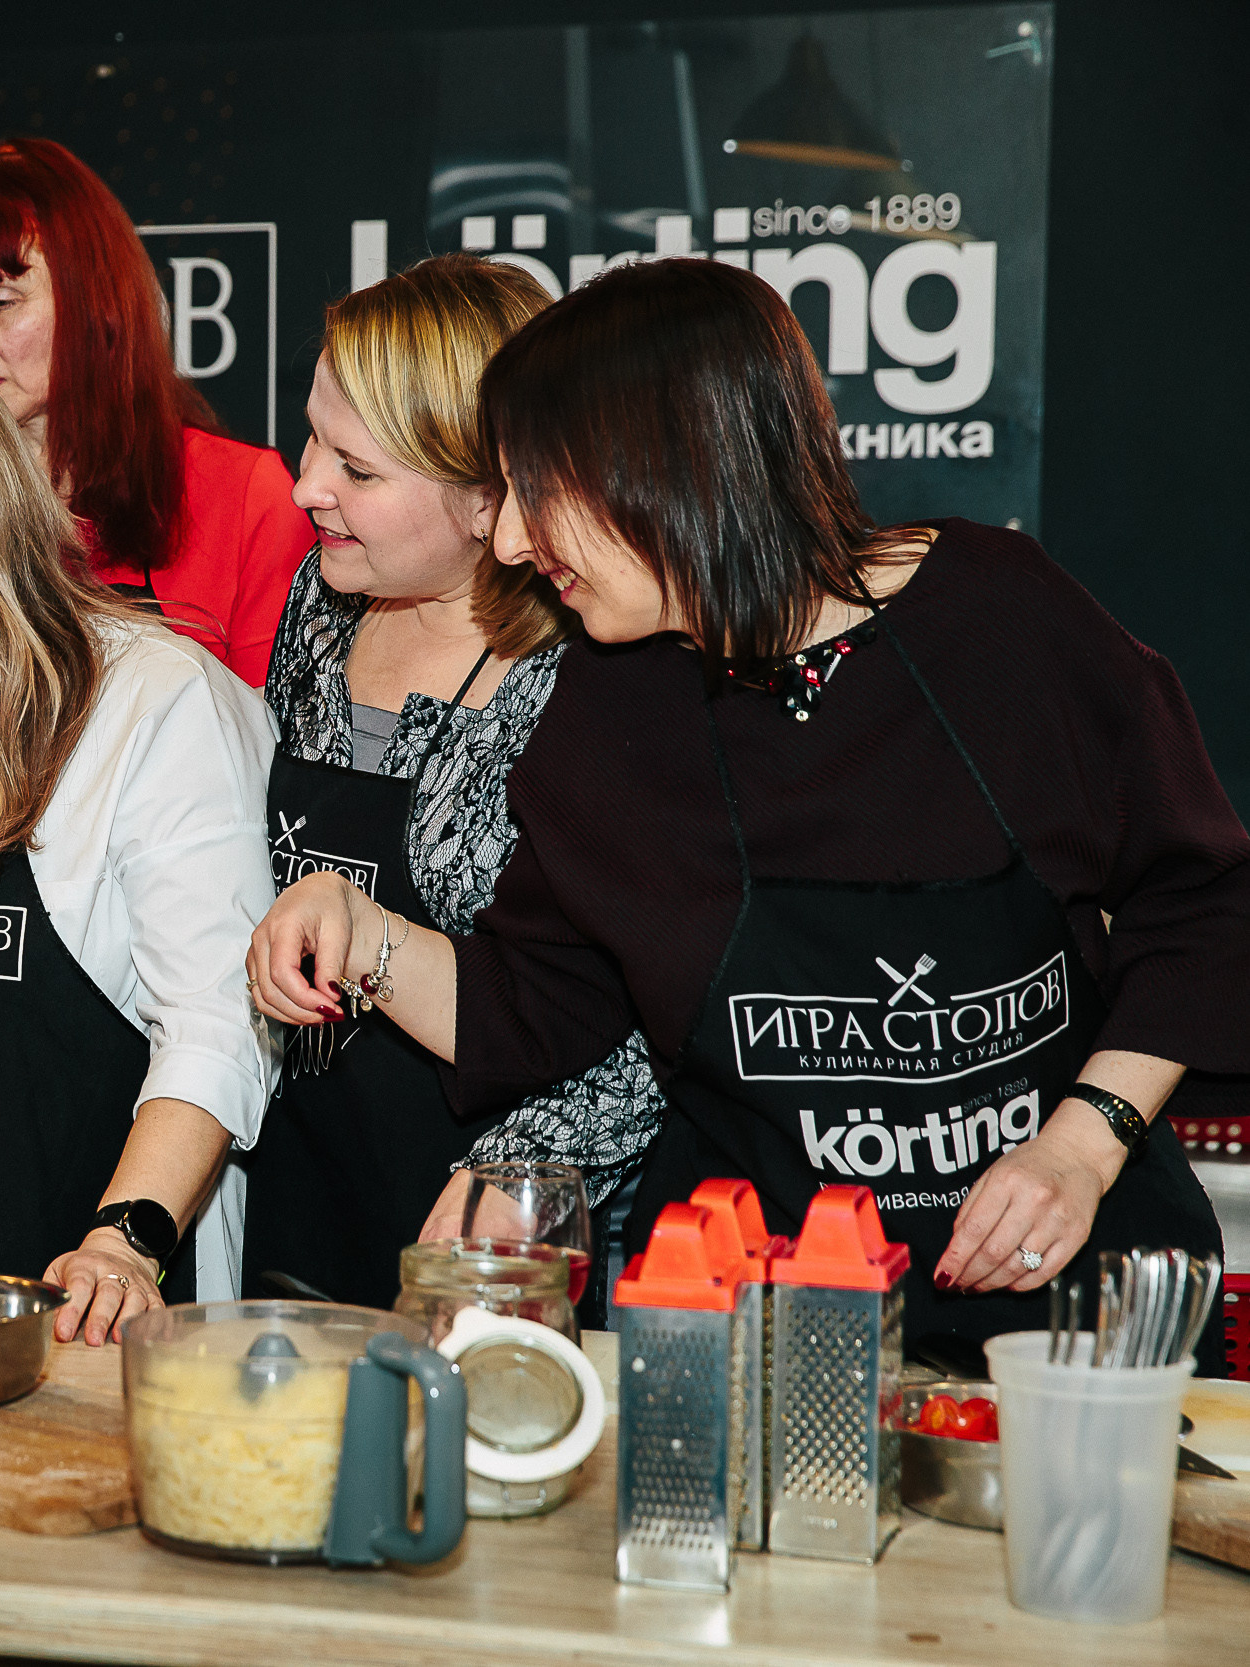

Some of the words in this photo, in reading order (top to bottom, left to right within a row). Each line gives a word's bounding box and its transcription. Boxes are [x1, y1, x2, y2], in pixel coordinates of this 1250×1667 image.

[864, 192, 961, 233] 1889
[840, 420, 995, 460] ника
[743, 1006, 874, 1050] ИГРА
[883, 969, 1061, 1052] СТОЛОВ
[799, 1053, 940, 1072] КУЛИНАРНАЯ
[952, 1031, 1024, 1067] СТУДИЯ
